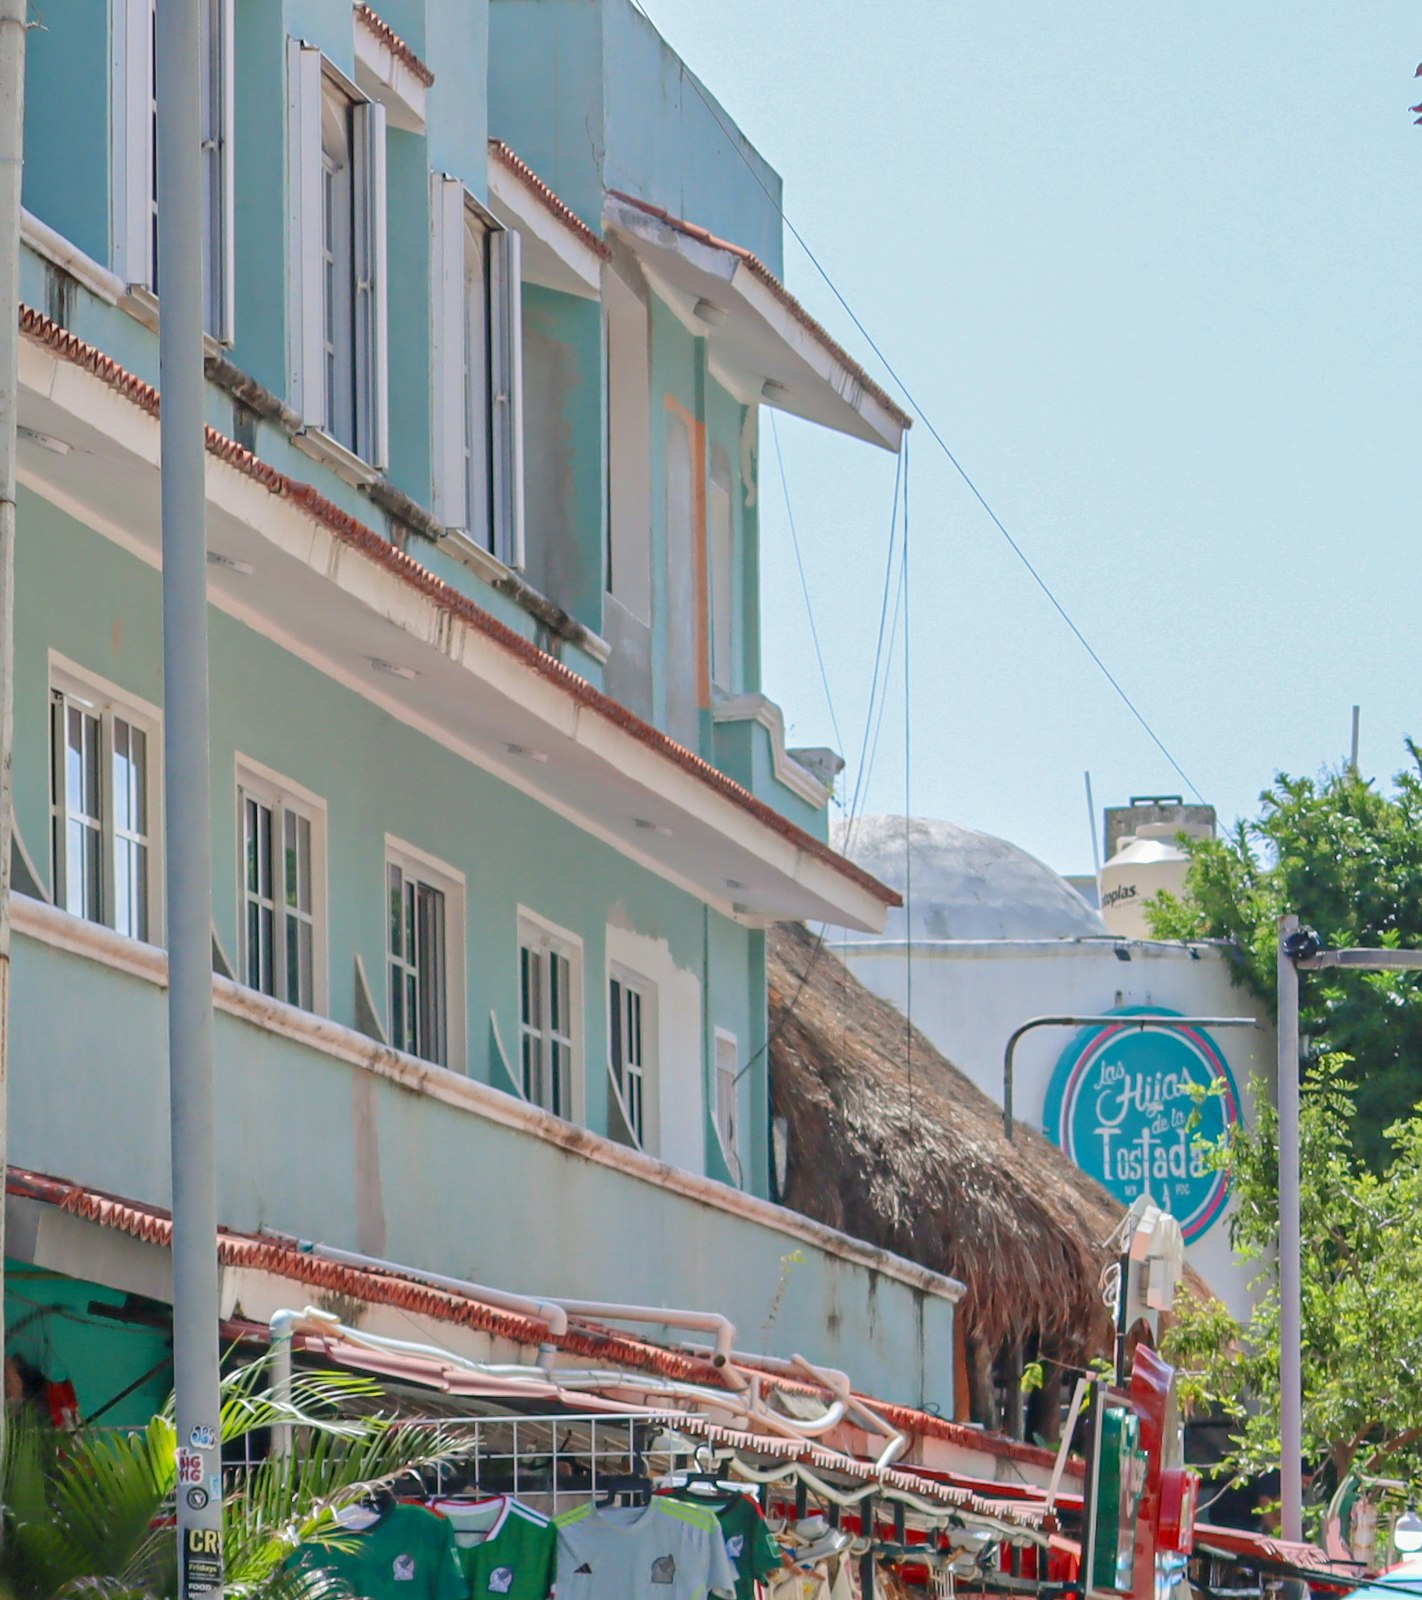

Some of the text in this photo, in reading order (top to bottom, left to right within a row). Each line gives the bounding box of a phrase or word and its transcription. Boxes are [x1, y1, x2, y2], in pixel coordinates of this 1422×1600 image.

[1096, 1066, 1192, 1127] Hijas
[1152, 1108, 1186, 1134] de la
